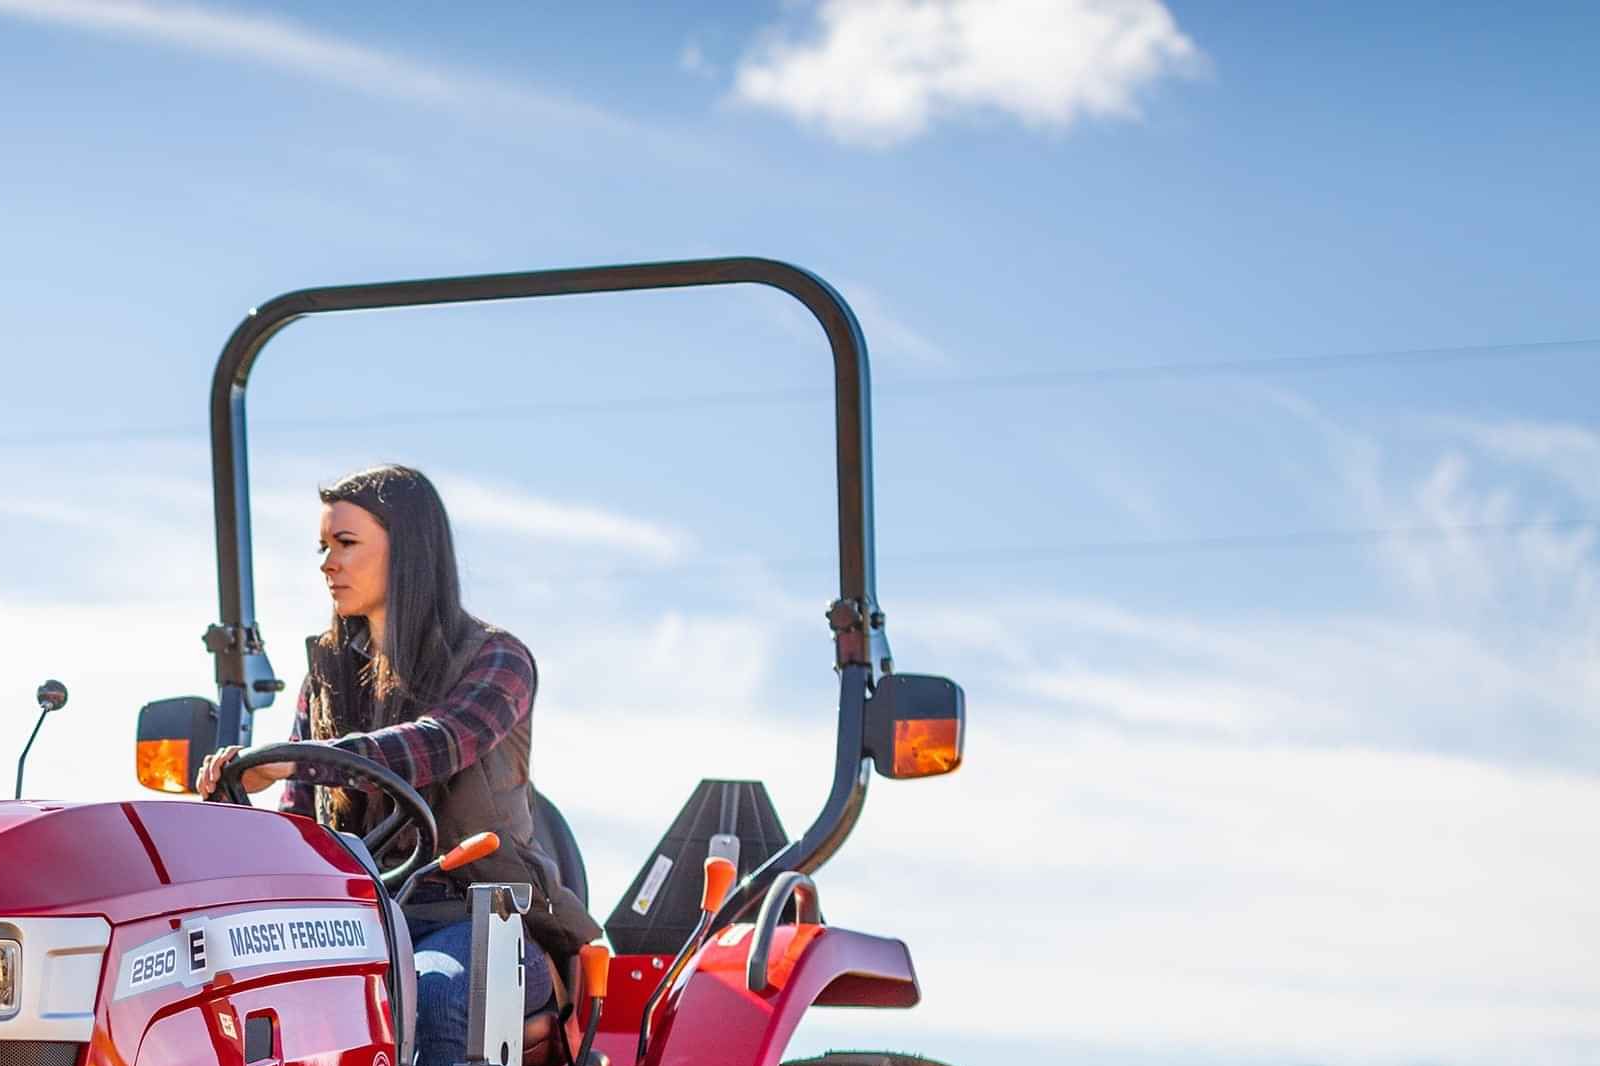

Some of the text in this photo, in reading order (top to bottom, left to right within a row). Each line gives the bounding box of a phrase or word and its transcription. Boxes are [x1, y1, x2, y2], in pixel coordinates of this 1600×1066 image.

[131, 929, 206, 984] 2850 E
[228, 919, 366, 957] MASSEY FERGUSON
